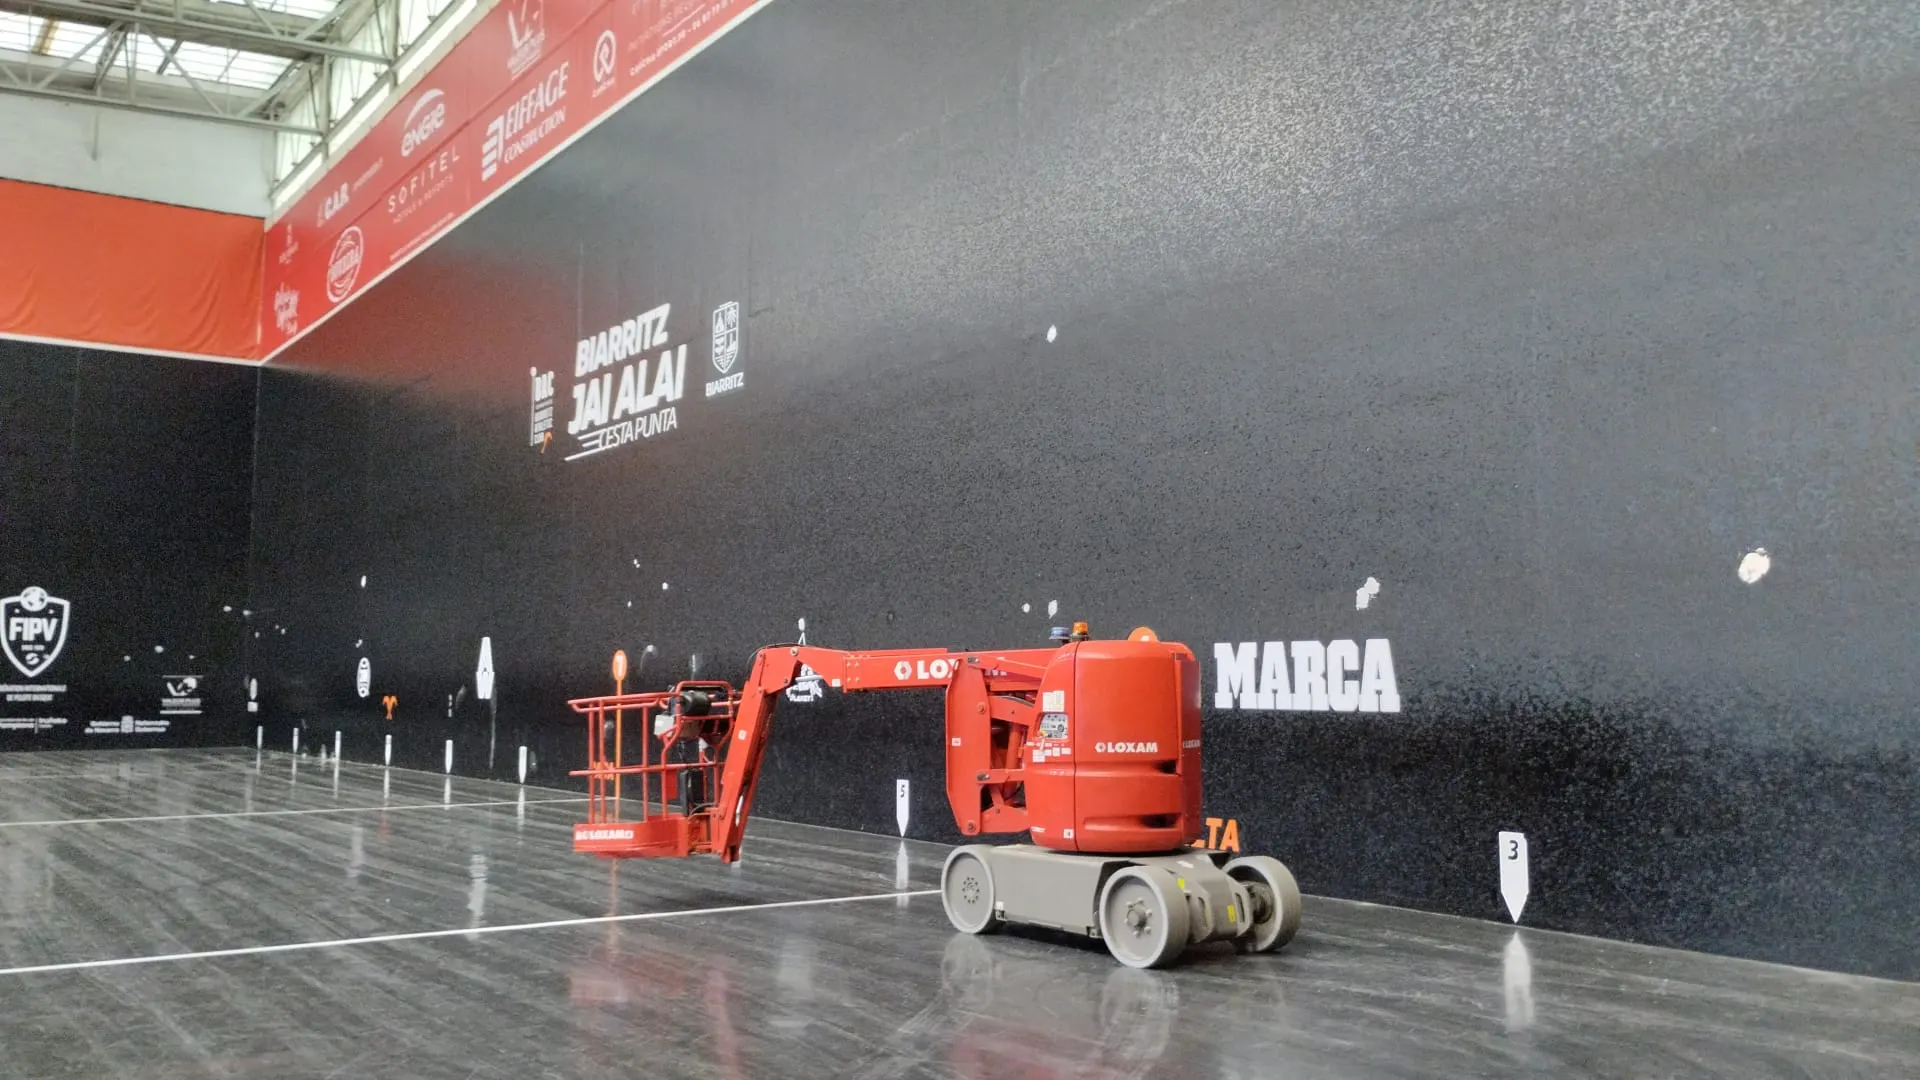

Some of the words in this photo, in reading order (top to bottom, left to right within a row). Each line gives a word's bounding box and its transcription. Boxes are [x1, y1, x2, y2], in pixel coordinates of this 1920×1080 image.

[505, 61, 569, 141] EIFFAGE
[504, 105, 566, 165] CONSTRUCTION
[387, 144, 461, 214] SOFITEL
[574, 303, 671, 378] BIARRITZ
[568, 372, 612, 435] JAI
[612, 343, 687, 420] ALAI
[705, 371, 745, 398] BIARRITZ
[599, 420, 634, 450] CESTA
[634, 406, 678, 440] PUNTA
[8, 616, 59, 642] FIPV
[916, 659, 959, 680] LOX
[1213, 637, 1401, 712] MARCA
[1107, 741, 1158, 753] LOXAM
[1508, 839, 1519, 860] 3
